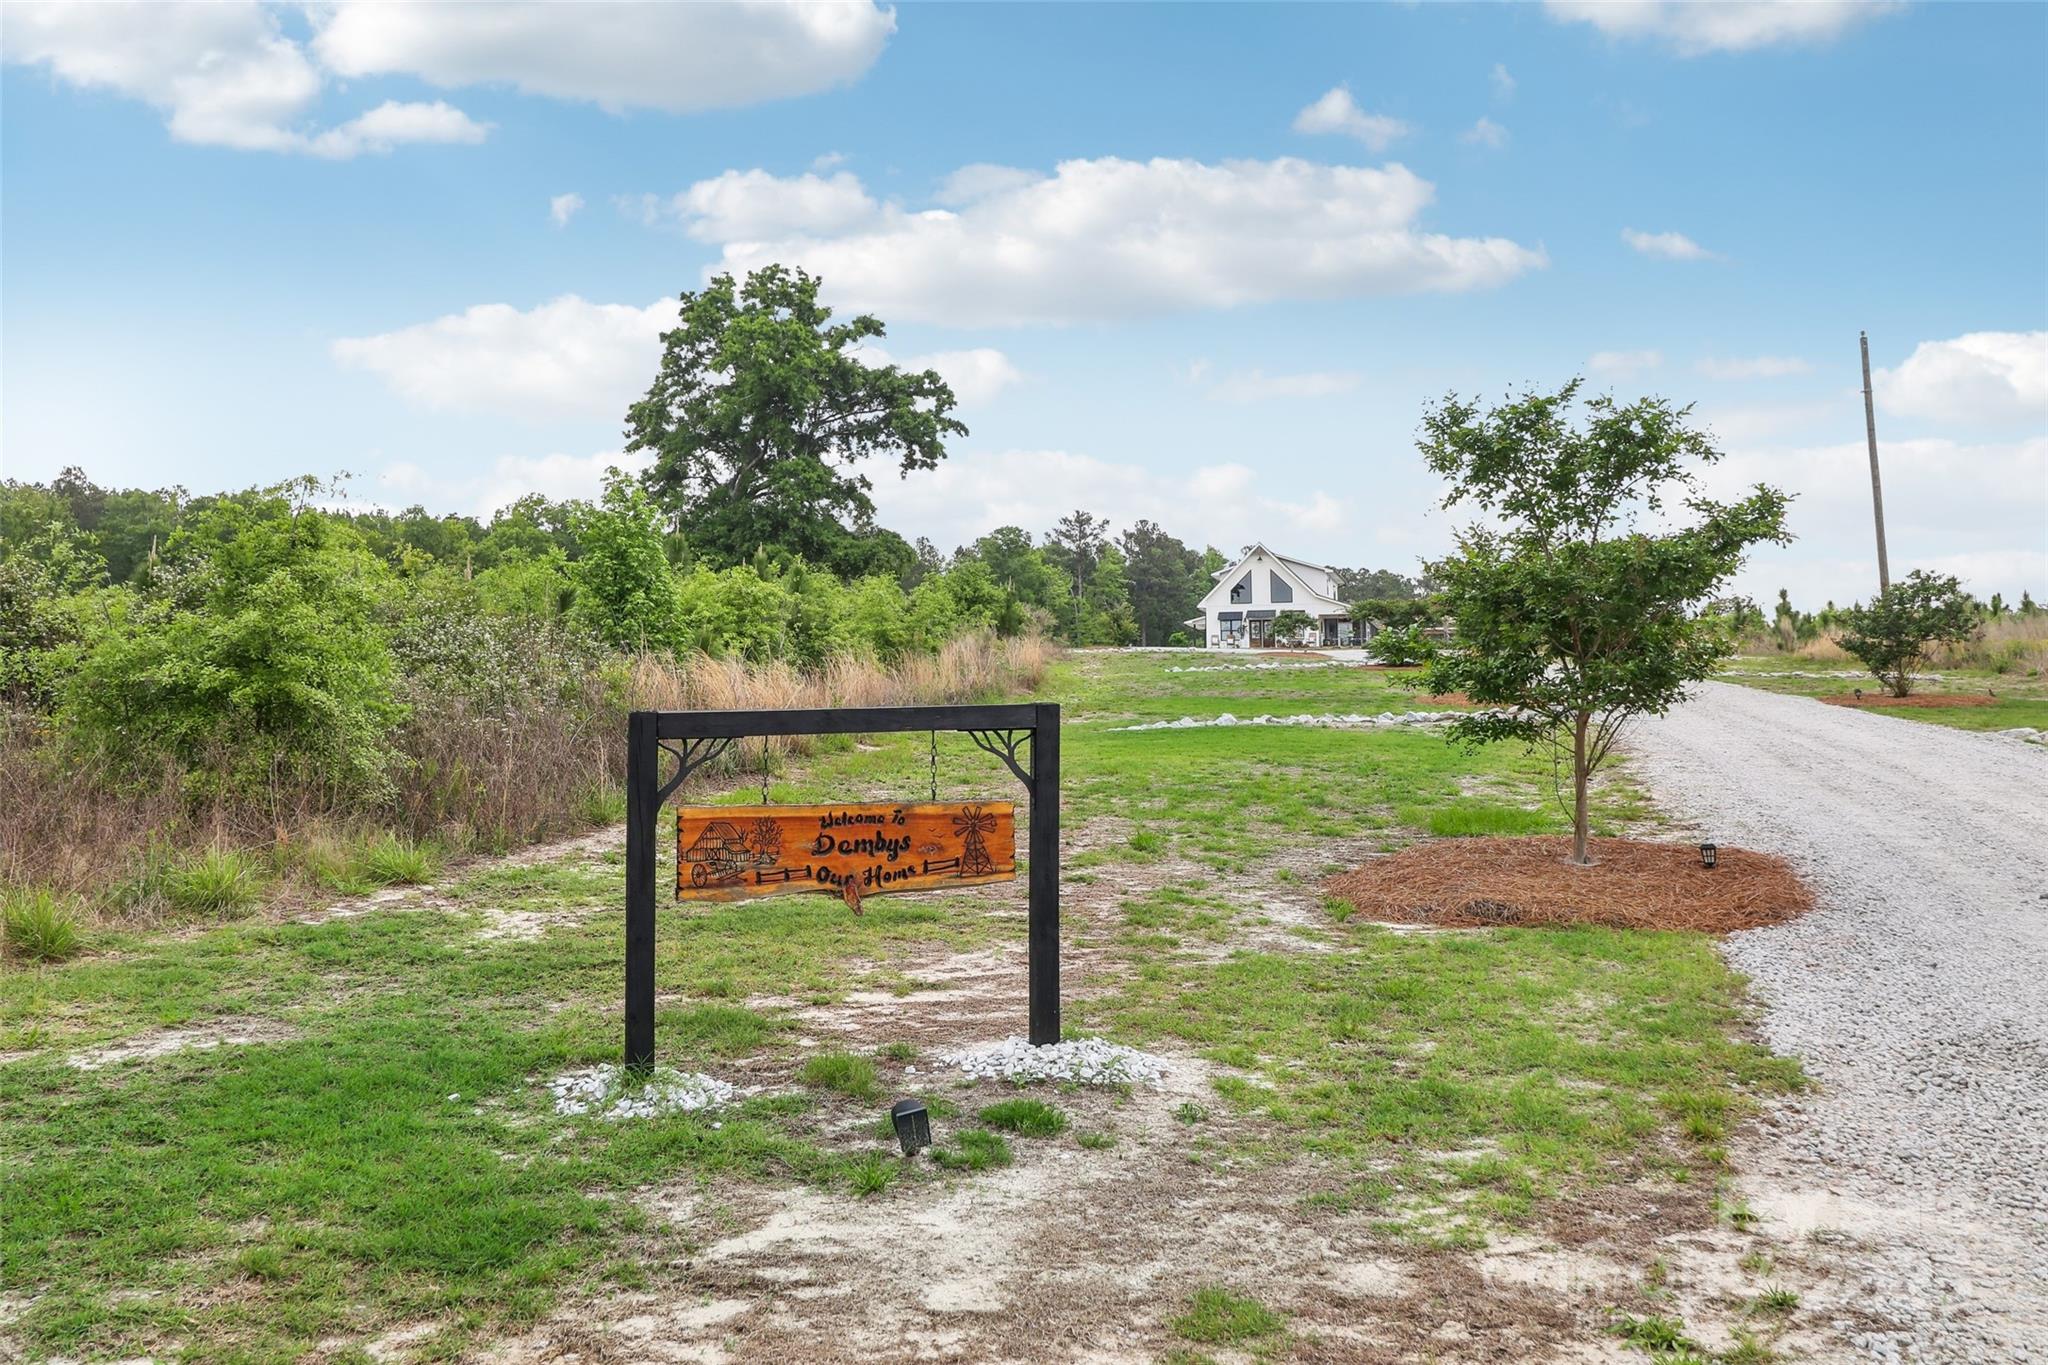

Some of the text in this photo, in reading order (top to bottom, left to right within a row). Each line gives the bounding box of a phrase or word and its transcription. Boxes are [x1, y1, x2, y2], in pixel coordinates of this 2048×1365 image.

[819, 809, 905, 829] Welcome To
[816, 865, 916, 888] Our Home
